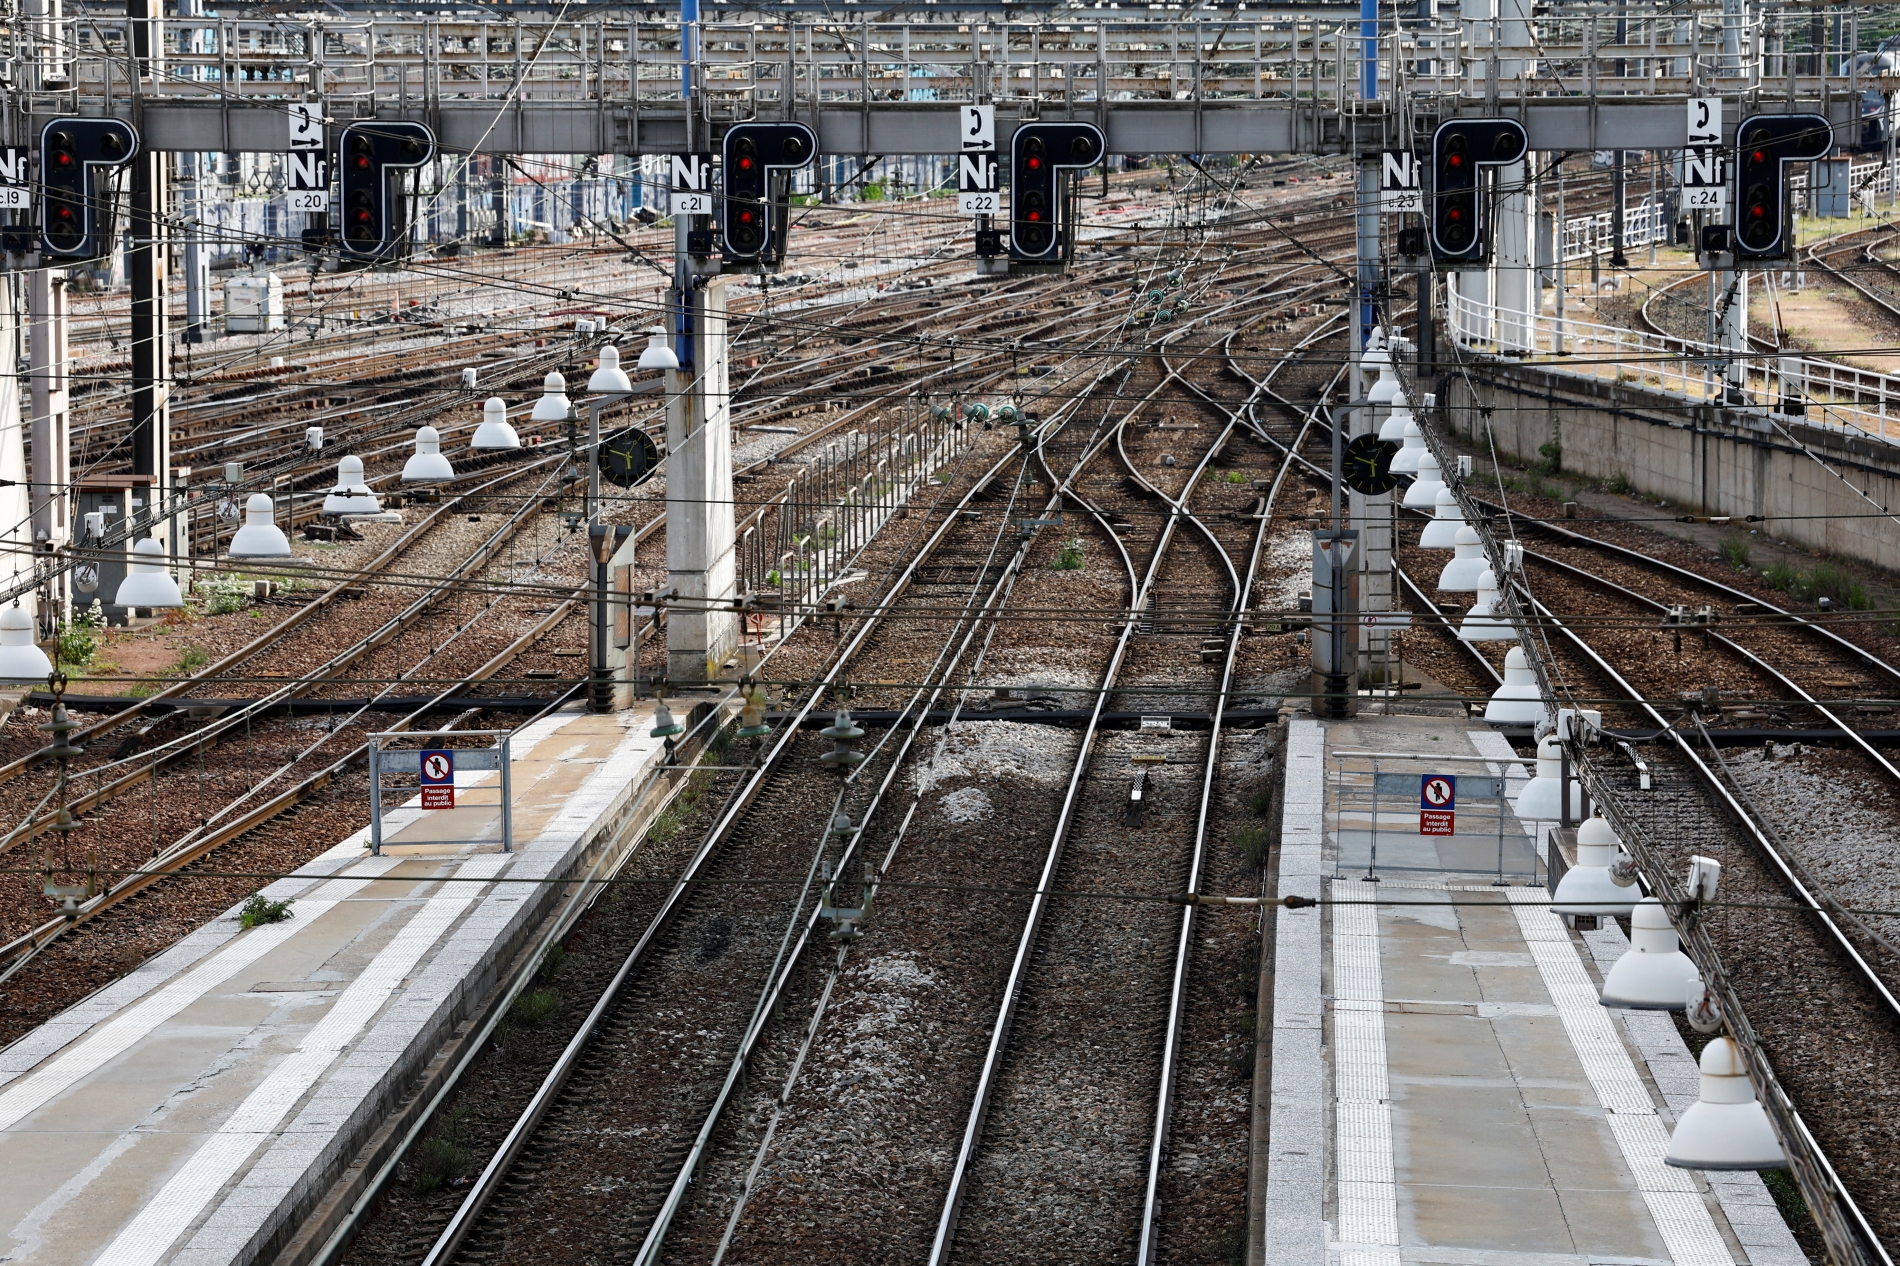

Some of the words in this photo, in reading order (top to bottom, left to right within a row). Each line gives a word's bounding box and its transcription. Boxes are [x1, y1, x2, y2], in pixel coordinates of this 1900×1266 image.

[287, 152, 327, 188] Nf
[671, 154, 710, 190] Nf
[959, 154, 998, 190] Nf
[1382, 152, 1422, 188] Nf
[1684, 147, 1725, 184] Nf
[294, 194, 322, 208] c.20
[966, 196, 993, 210] c.22
[1690, 190, 1718, 205] c.24
[1424, 812, 1451, 821] Passage
[1431, 826, 1452, 834] public
